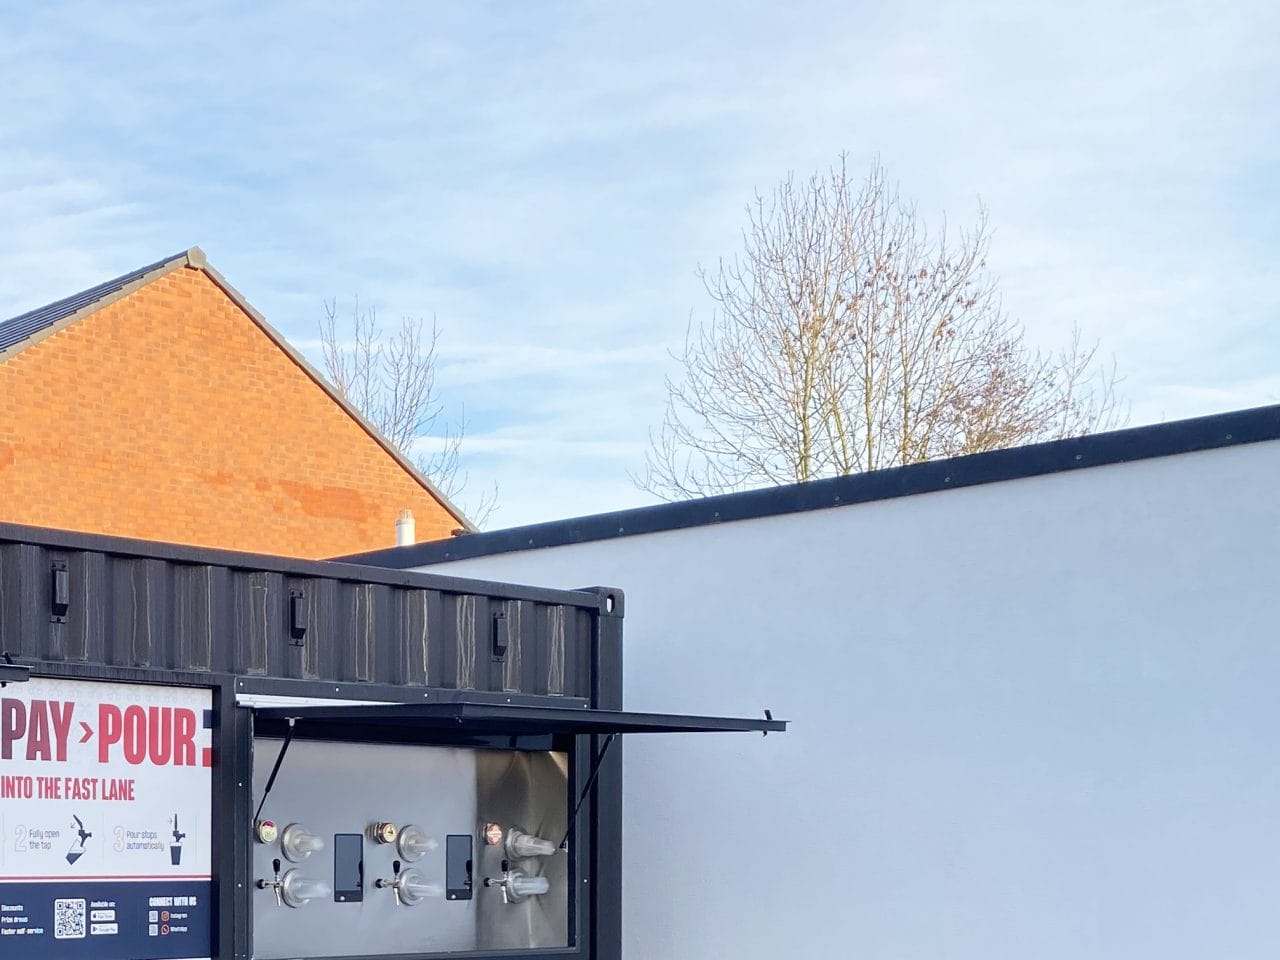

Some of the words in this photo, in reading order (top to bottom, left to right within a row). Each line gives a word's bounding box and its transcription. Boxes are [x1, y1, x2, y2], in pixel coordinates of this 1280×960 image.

[1, 697, 75, 762] PAY
[1, 775, 32, 799] INTO
[37, 776, 61, 799] THE
[64, 777, 98, 800] FAST
[102, 778, 135, 801] LANE
[29, 829, 43, 839] Fully
[45, 831, 59, 840] open
[127, 830, 140, 838] Pour
[141, 830, 157, 839] stops
[29, 840, 41, 849] the
[42, 841, 52, 850] tap
[127, 841, 164, 851] automatically
